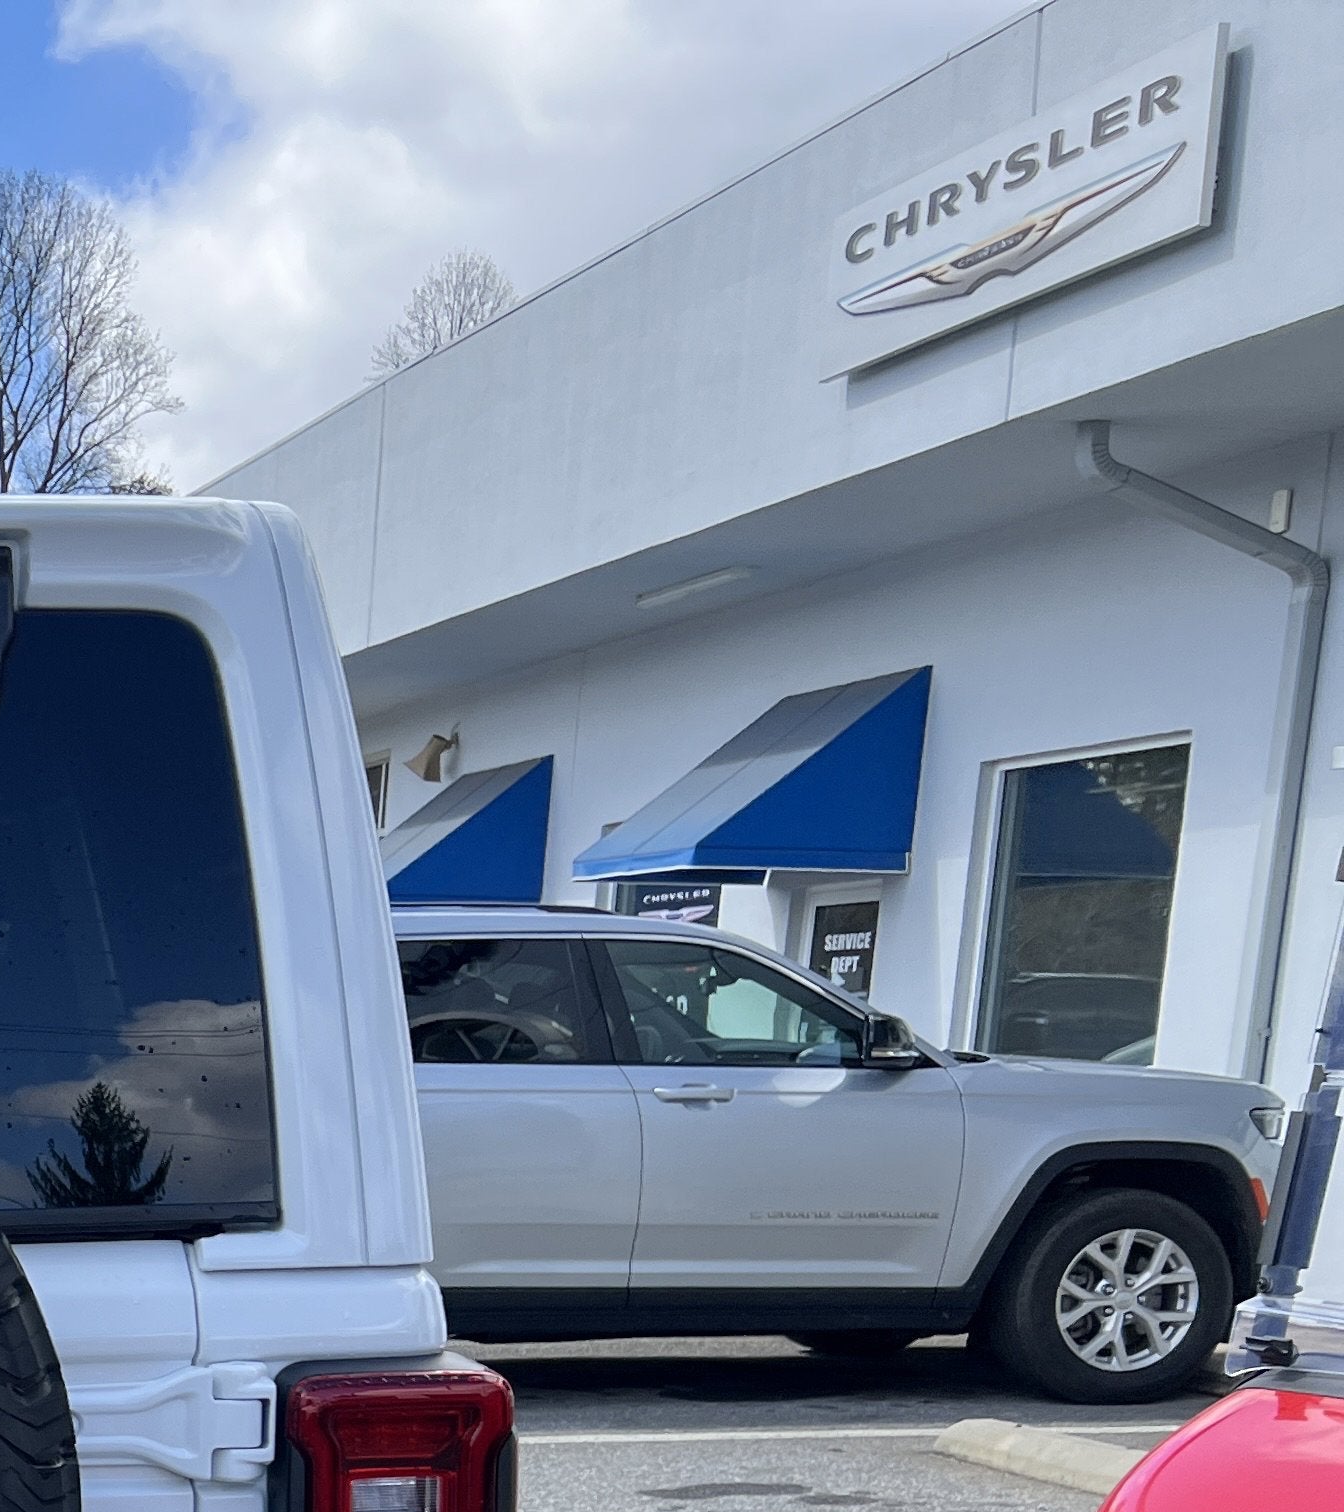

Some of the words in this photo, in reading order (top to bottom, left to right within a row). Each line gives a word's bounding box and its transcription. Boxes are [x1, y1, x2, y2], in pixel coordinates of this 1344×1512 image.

[845, 74, 1182, 264] CHRYSLER
[643, 889, 710, 904] CHRYSLER
[824, 931, 872, 952] SERVICE
[831, 956, 860, 974] DEPT
